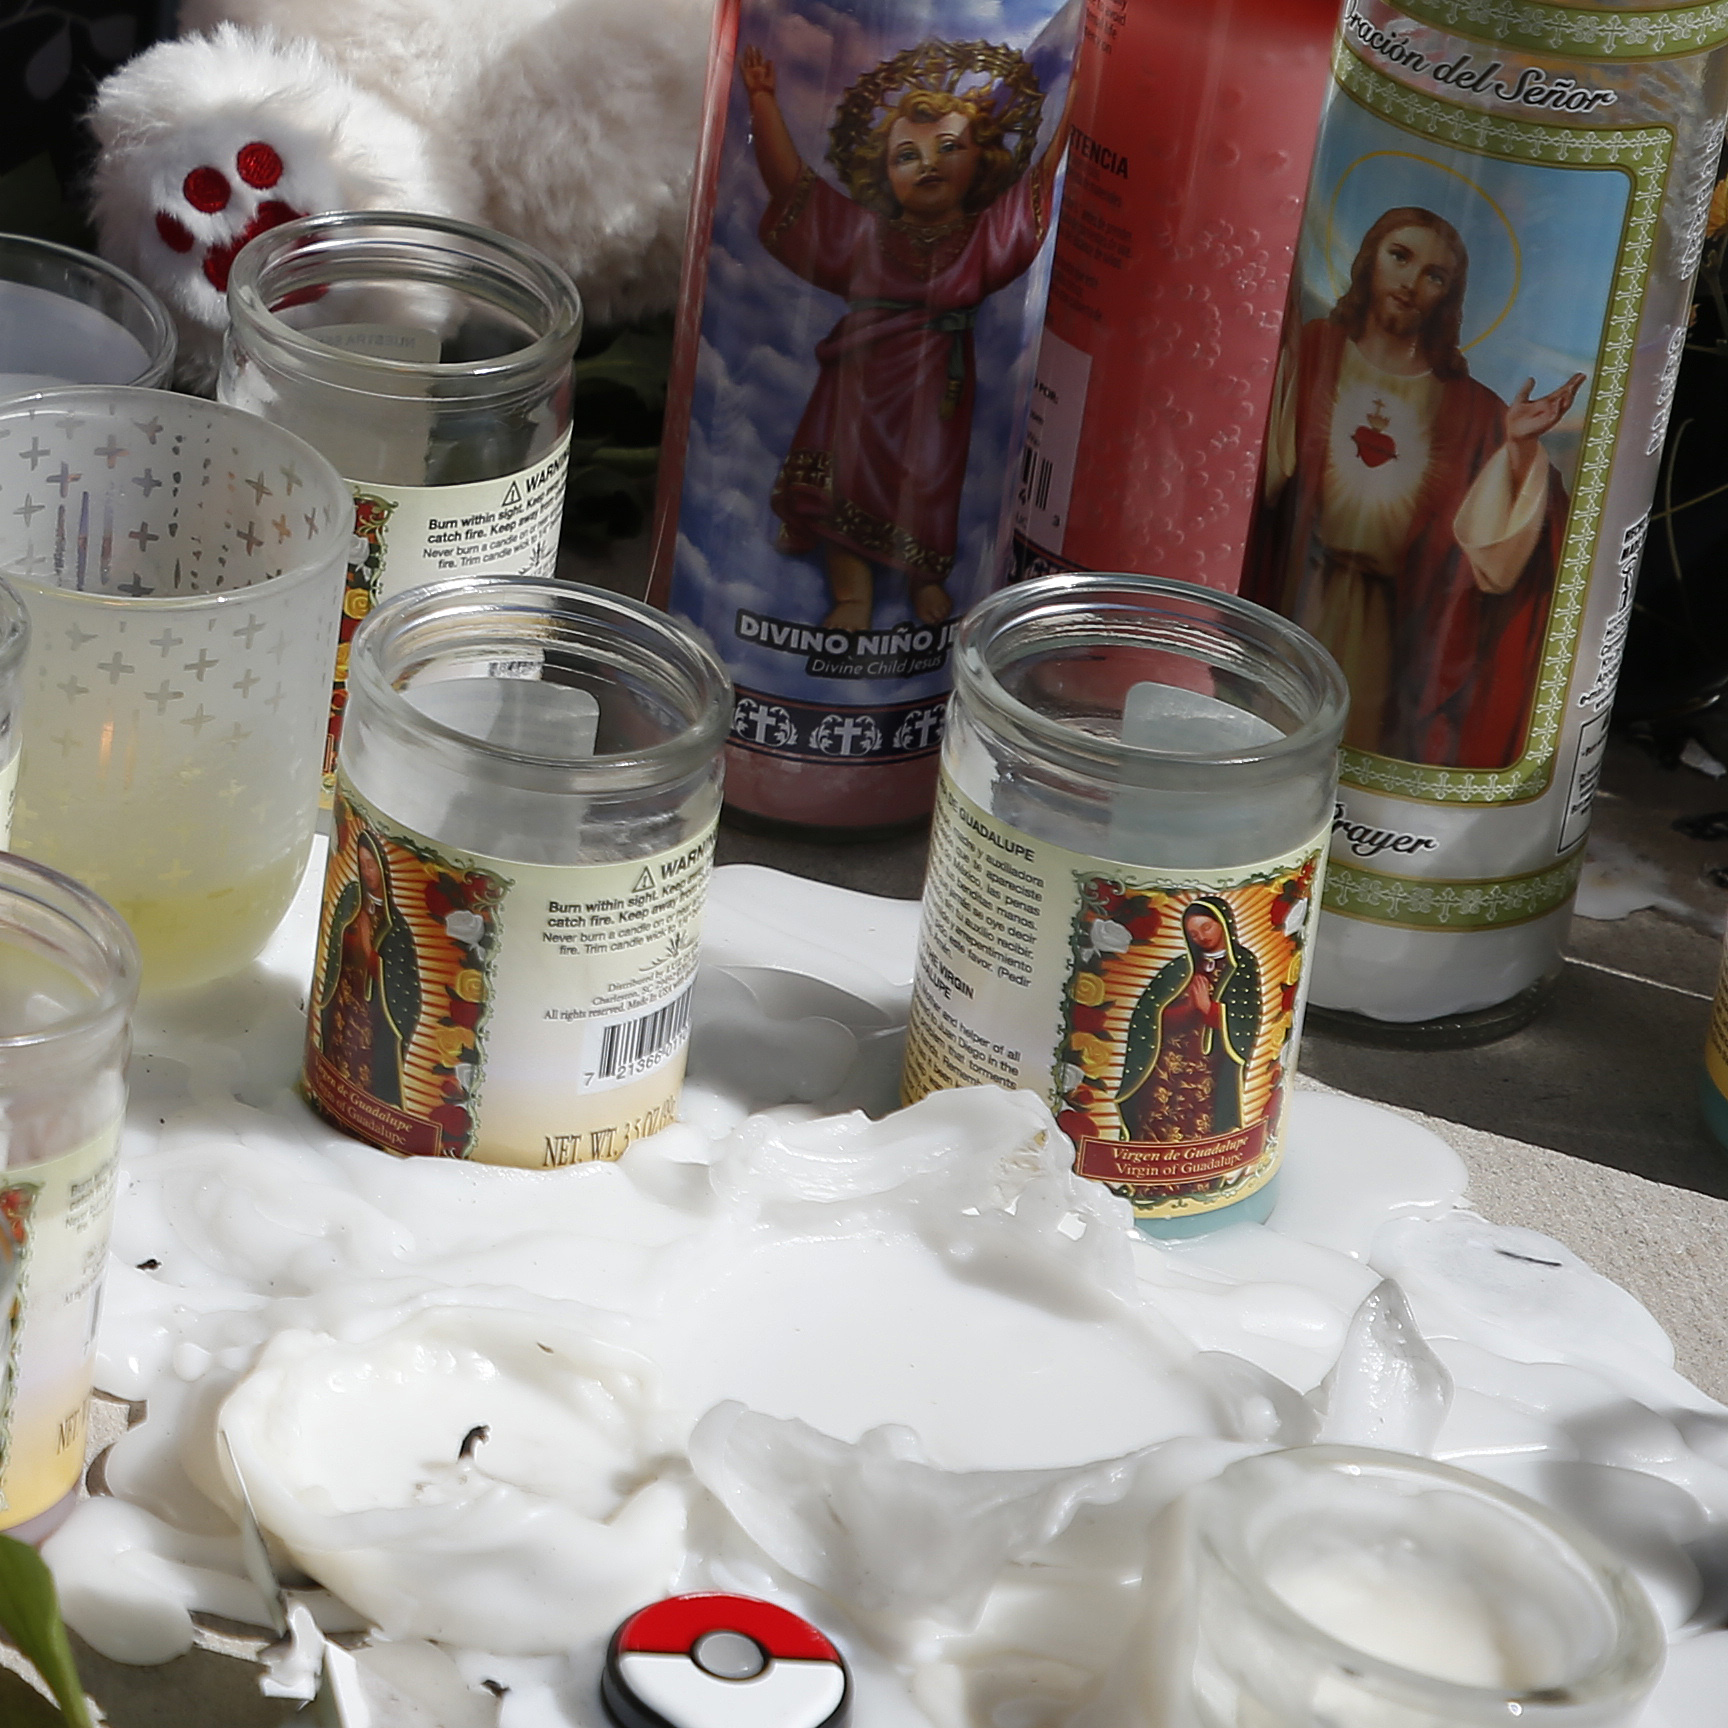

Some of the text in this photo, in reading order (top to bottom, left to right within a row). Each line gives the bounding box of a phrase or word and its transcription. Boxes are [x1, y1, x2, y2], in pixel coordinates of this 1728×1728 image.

[1432, 55, 1501, 93] del
[1496, 67, 1617, 112] Señor
[427, 520, 517, 544] catch fire. Keep
[428, 518, 458, 530] Burn
[461, 513, 495, 527] within
[423, 533, 518, 559] Never burn candle
[438, 546, 512, 569] fire. Trim candle
[740, 614, 849, 654] DIVINO
[857, 627, 933, 656] NIÑO
[812, 655, 942, 675] Divine Child Jesus
[959, 807, 1035, 863] GUADALUPE
[986, 852, 1044, 889] auxiliadora
[986, 870, 1043, 903] apareciste
[987, 882, 1041, 917] las penas
[549, 901, 582, 913] Burn
[585, 899, 624, 913] within
[628, 891, 659, 908] sight.
[547, 908, 649, 928] catch fire. Keep
[986, 915, 1038, 945] oye decir
[996, 906, 1038, 932] manos.
[543, 922, 651, 943] Never burn candle
[559, 936, 644, 955] fire. Trim candle
[997, 936, 1034, 960] recibir.
[939, 962, 975, 1000] VIRGIN
[968, 949, 1032, 988] favor. (Pedir
[544, 1005, 626, 1022] All rights reserved.
[958, 1036, 1019, 1076] Diego the
[959, 1022, 1022, 1063] helper all
[584, 1072, 595, 1086] 7
[969, 1060, 1018, 1090] torments
[347, 1106, 407, 1146] Guadalupe
[350, 1092, 414, 1133] Guadalupe
[543, 1127, 618, 1167] NET. WT.
[1113, 1136, 1249, 1163] Virgen de Guadalupe
[1115, 1152, 1244, 1178] Virgin of Guadalupe
